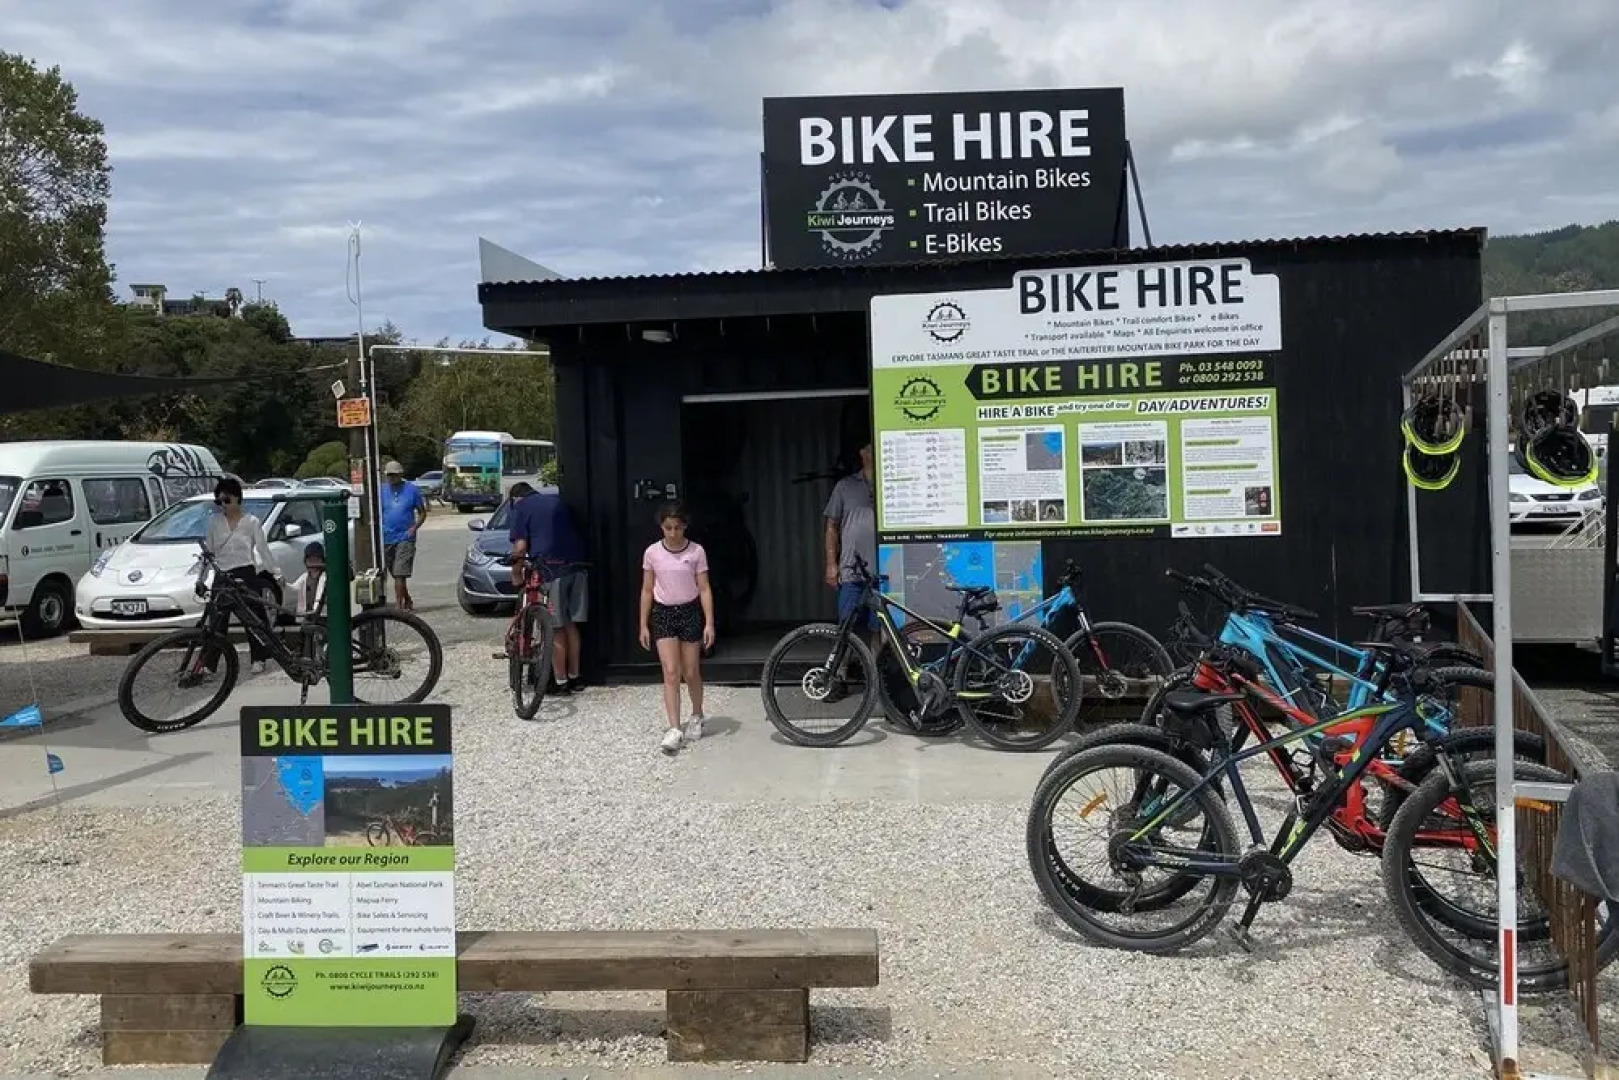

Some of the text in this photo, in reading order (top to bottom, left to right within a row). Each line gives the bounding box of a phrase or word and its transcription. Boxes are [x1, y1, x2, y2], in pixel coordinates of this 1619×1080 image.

[800, 109, 1092, 165] BIKE HIRE
[923, 168, 1091, 192] Mountain Bikes
[807, 214, 894, 227] Kiwi Journeys
[923, 201, 1032, 222] Trail Bikes
[925, 234, 1003, 253] E-Bikes
[1020, 263, 1244, 315] BIKE HIRE
[1053, 320, 1091, 328] Mountain
[1141, 316, 1172, 324] comfort
[1174, 314, 1195, 322] Bikes
[1218, 312, 1240, 320] Bikes
[1031, 333, 1067, 342] Transport
[1070, 331, 1104, 340] available
[1113, 330, 1135, 338] Maps
[1156, 328, 1192, 336] Enquiries
[1194, 325, 1229, 333] welcome
[1240, 323, 1263, 331] office
[891, 354, 924, 363] EXPLORE
[927, 352, 963, 361] TASMANS
[966, 350, 991, 359] GREAT
[993, 349, 1015, 357] TASTE
[1018, 349, 1039, 357] TRAIL
[1052, 347, 1066, 355] THE
[1117, 343, 1162, 352] MOUNTAIN
[1164, 342, 1181, 350] BIKE
[1184, 341, 1205, 349] PARK
[1207, 339, 1224, 347] FOR
[1226, 338, 1240, 346] THE
[1242, 337, 1260, 346] DAY
[1179, 360, 1264, 372] Ph. 03 548 0093
[982, 362, 1163, 393] BIKE HIRE
[1178, 371, 1264, 384] or 0800 292 538
[978, 407, 1008, 418] HIRE
[1012, 407, 1021, 417] A
[1025, 406, 1055, 417] BIKE
[1075, 403, 1086, 412] try
[1106, 401, 1114, 409] of
[1138, 396, 1268, 412] DAY/ADVENTURES!
[258, 716, 434, 747] BIKE HIRE
[287, 853, 409, 868] Explore our Region
[350, 971, 373, 979] CYCLE
[375, 971, 401, 979] TRAILS
[403, 971, 420, 979] (292
[421, 971, 439, 979] 538)
[329, 983, 425, 992] www.kiwijourneys.co.nz
